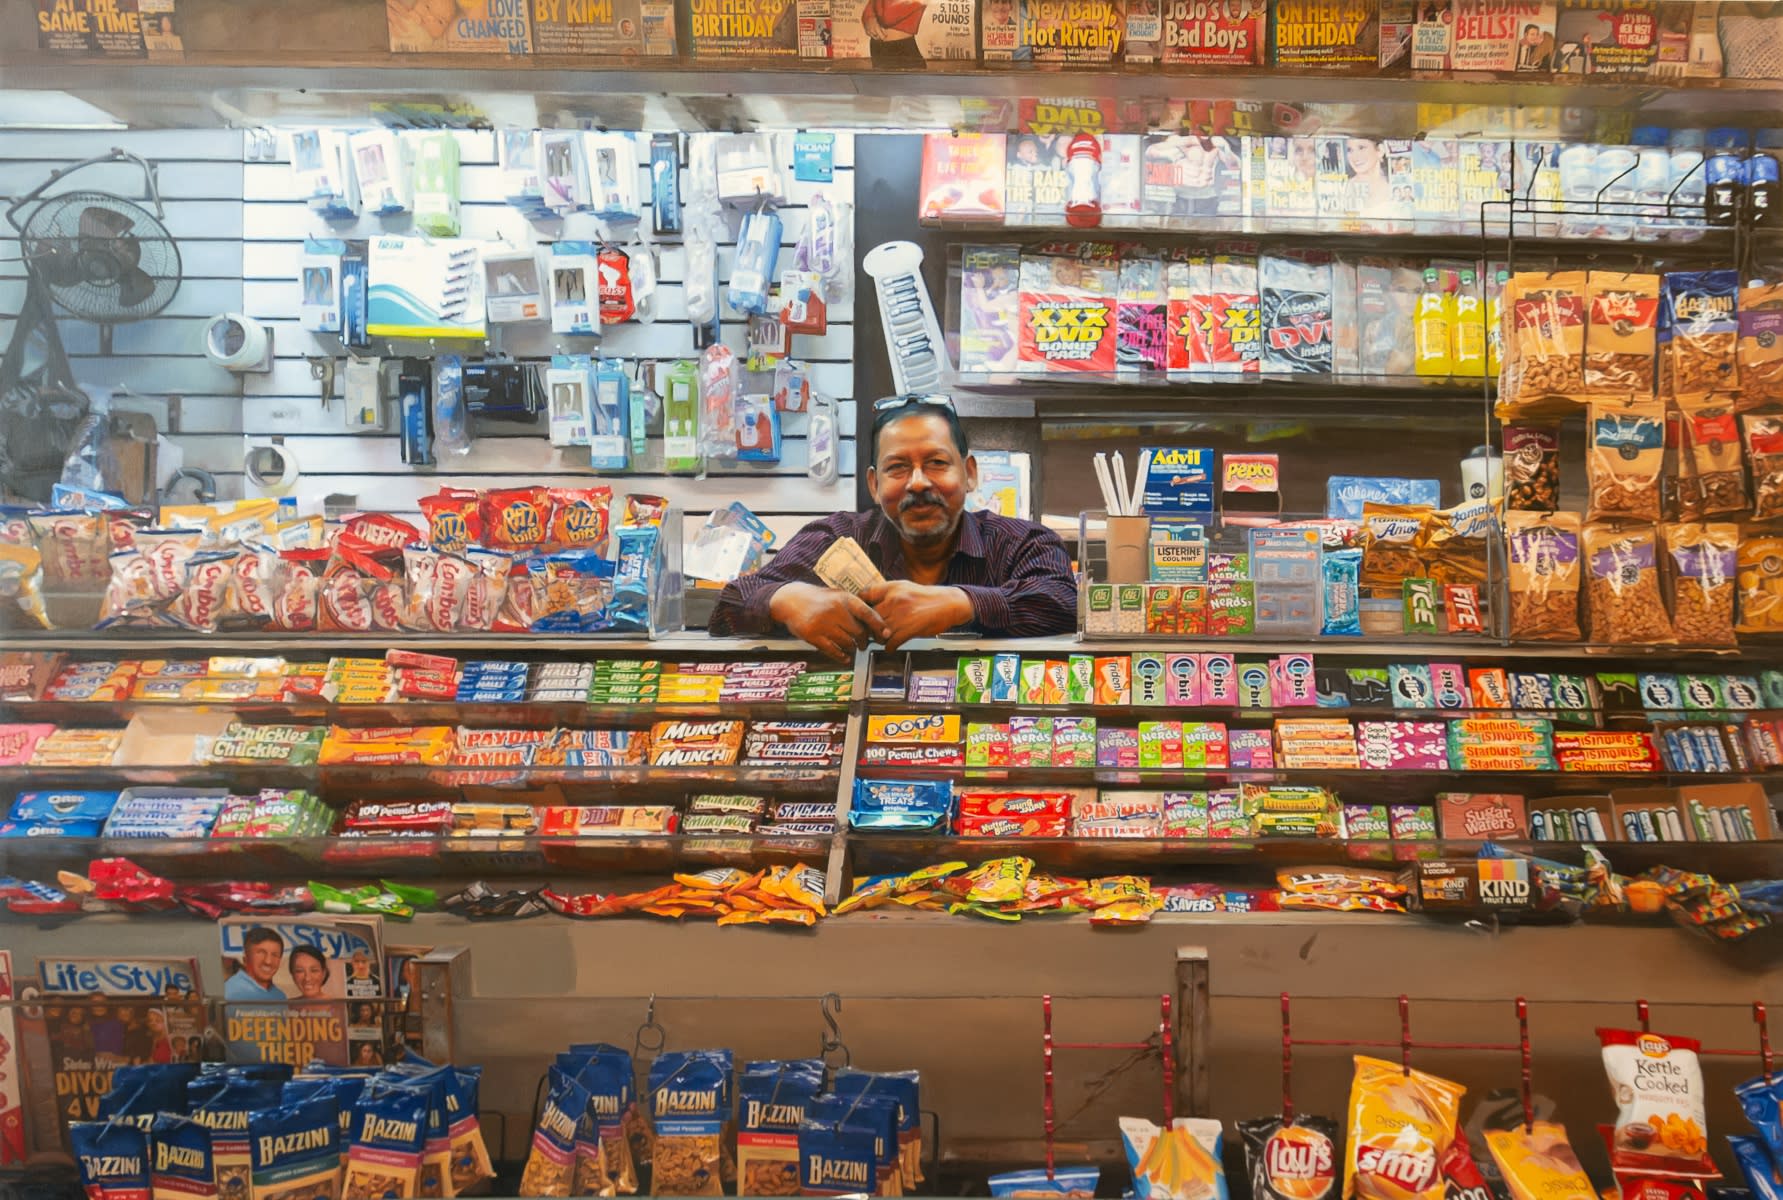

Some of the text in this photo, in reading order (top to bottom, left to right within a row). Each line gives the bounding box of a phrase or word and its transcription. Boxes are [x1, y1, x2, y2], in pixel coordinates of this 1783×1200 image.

[487, 0, 526, 17] LOVE
[536, 0, 613, 24] BY KIM!
[1028, 0, 1117, 26] New Baby,
[1165, 0, 1220, 20] JoJo's
[38, 13, 142, 33] SAME TIME
[692, 15, 775, 37] BIRTHDAY
[932, 13, 970, 25] POUNDS
[457, 18, 527, 39] CHANGED
[1023, 21, 1056, 46] Hot
[1061, 20, 1122, 53] Rivalry
[1166, 20, 1201, 47] Bad
[1204, 21, 1247, 53] Boys
[1277, 23, 1360, 46] BIRTHDAY
[1455, 16, 1515, 41] BELLS!
[508, 41, 528, 56] ME
[1031, 307, 1107, 328] XXX
[1035, 327, 1102, 342] DVD
[1038, 341, 1098, 352] BONUS
[1046, 350, 1090, 361] PACK
[1301, 346, 1331, 358] Inside
[1153, 450, 1201, 466] Advil
[1228, 462, 1275, 483] Pepto
[433, 513, 466, 538] RITZ
[503, 508, 537, 529] RITZ
[563, 507, 600, 528] RITZ
[1157, 547, 1201, 556] LISTERINE
[439, 562, 459, 628] Combos
[1410, 581, 1435, 625] ICE
[1450, 585, 1479, 628] FIRE
[481, 663, 509, 672] HALLS
[611, 661, 641, 671] HALLS
[697, 661, 725, 671] HALLS
[752, 667, 779, 677] HALLS
[1006, 656, 1016, 686] Trident
[1080, 658, 1089, 688] Trident
[476, 680, 507, 689] HALLS
[611, 672, 641, 682] HALLS
[742, 679, 773, 688] HALLS
[970, 659, 985, 693] Trident
[1056, 664, 1066, 692] Trident
[1107, 661, 1121, 692] Trident
[472, 692, 503, 701] HALLS
[609, 684, 640, 695] HALLS
[739, 692, 768, 701] HALLS
[1483, 673, 1502, 705] Trident
[228, 722, 306, 743] Chuckles
[664, 722, 733, 743] MUNCH
[884, 715, 945, 736] DOTS
[1366, 725, 1388, 737] Good
[1465, 721, 1517, 733] Starburst
[467, 730, 546, 748] PAYDAY
[1367, 735, 1389, 743] Plenty
[213, 740, 290, 759] Chuckles
[656, 747, 727, 766] MUNCH
[866, 745, 958, 760] 100 Peanut Chews
[1366, 747, 1388, 758] Good
[1465, 746, 1519, 758] Starburst
[1366, 757, 1390, 768] Plenty
[1469, 759, 1524, 770] Starburst
[128, 802, 182, 812] mentos
[358, 803, 451, 818] 100 Peanut Chews
[779, 804, 837, 817] SNICKER
[879, 797, 914, 806] TREATS
[688, 816, 751, 830] Milky Way
[1463, 806, 1511, 825] Sugar
[27, 826, 65, 837] OREO
[112, 828, 169, 839] mentos
[981, 818, 1003, 832] Nutter
[994, 821, 1022, 836] Butter
[1463, 818, 1515, 838] Wafers
[1429, 867, 1456, 875] COCONUT
[1443, 878, 1464, 889] KIND
[1478, 879, 1530, 897] KIND
[1170, 898, 1214, 912] SAVERS
[1482, 897, 1503, 905] FRUIT
[303, 927, 378, 960] Style
[40, 960, 191, 998] Life Style
[228, 1017, 343, 1042] DEFENDING
[256, 1043, 315, 1067] THEIR
[1640, 1039, 1669, 1055] Lay's
[1636, 1059, 1681, 1077] Kettle
[1634, 1078, 1689, 1095] Cooked
[654, 1087, 717, 1117] BAZZINI
[747, 1100, 805, 1129] BAZZINI
[360, 1114, 418, 1143] BAZZINI
[259, 1127, 330, 1166] BAZZINI
[157, 1141, 205, 1171] BAZZINI
[1270, 1139, 1334, 1178] Lay's
[81, 1156, 141, 1181] BAZZINI
[808, 1154, 868, 1183] BAZZINI
